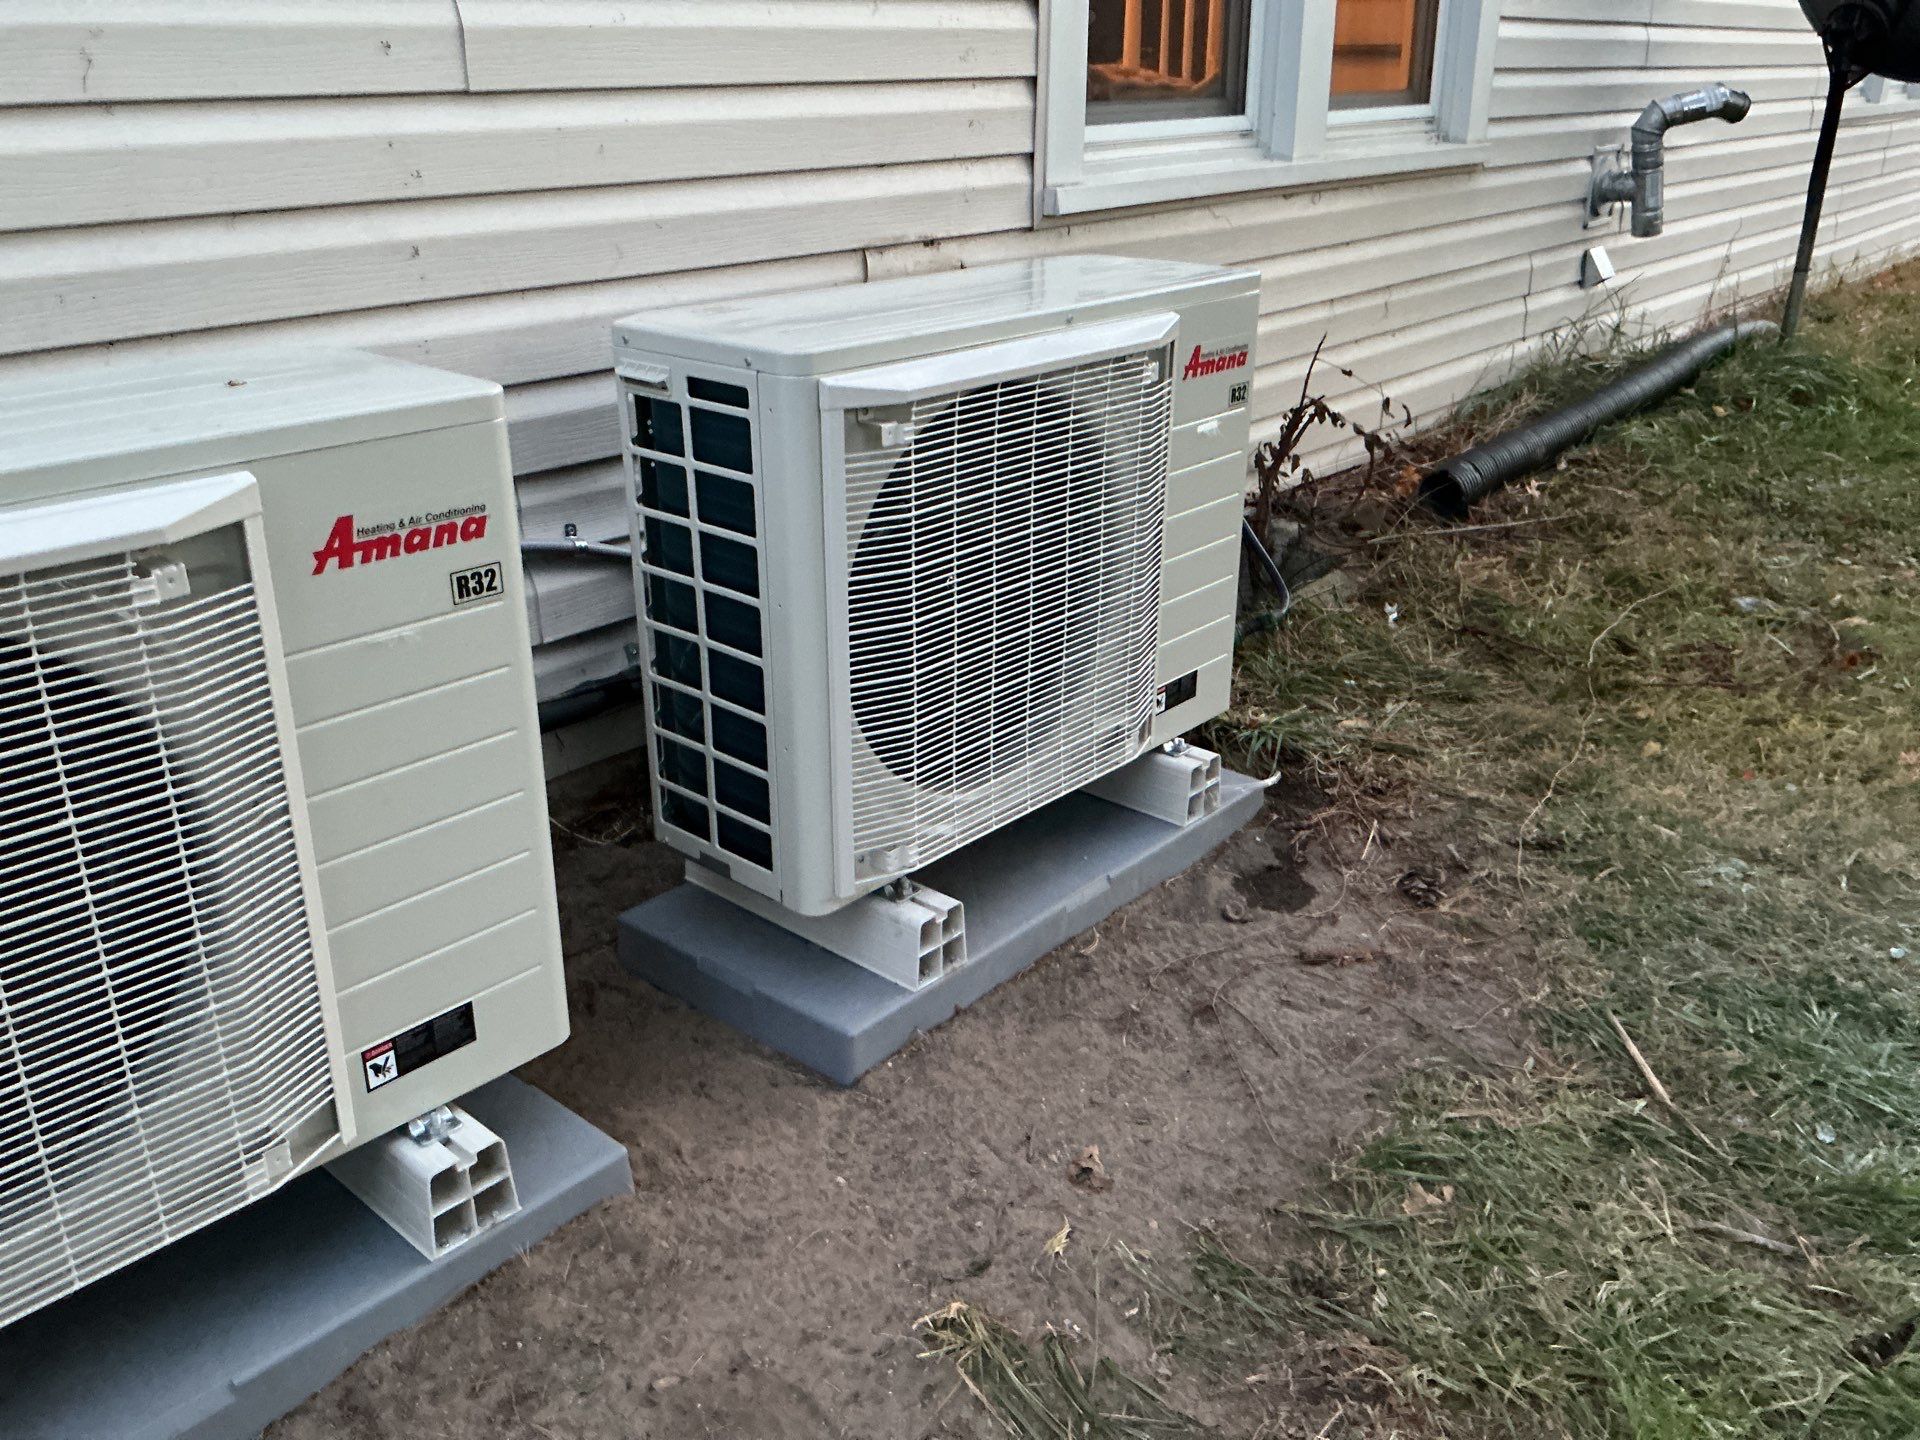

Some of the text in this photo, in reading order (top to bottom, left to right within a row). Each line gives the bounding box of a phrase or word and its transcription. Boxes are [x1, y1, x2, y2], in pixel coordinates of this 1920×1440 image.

[1183, 345, 1249, 380] Amana
[1231, 385, 1247, 403] R32
[357, 503, 487, 537] Heating & Air Conditioning
[312, 514, 488, 575] Amana
[456, 568, 498, 600] R32
